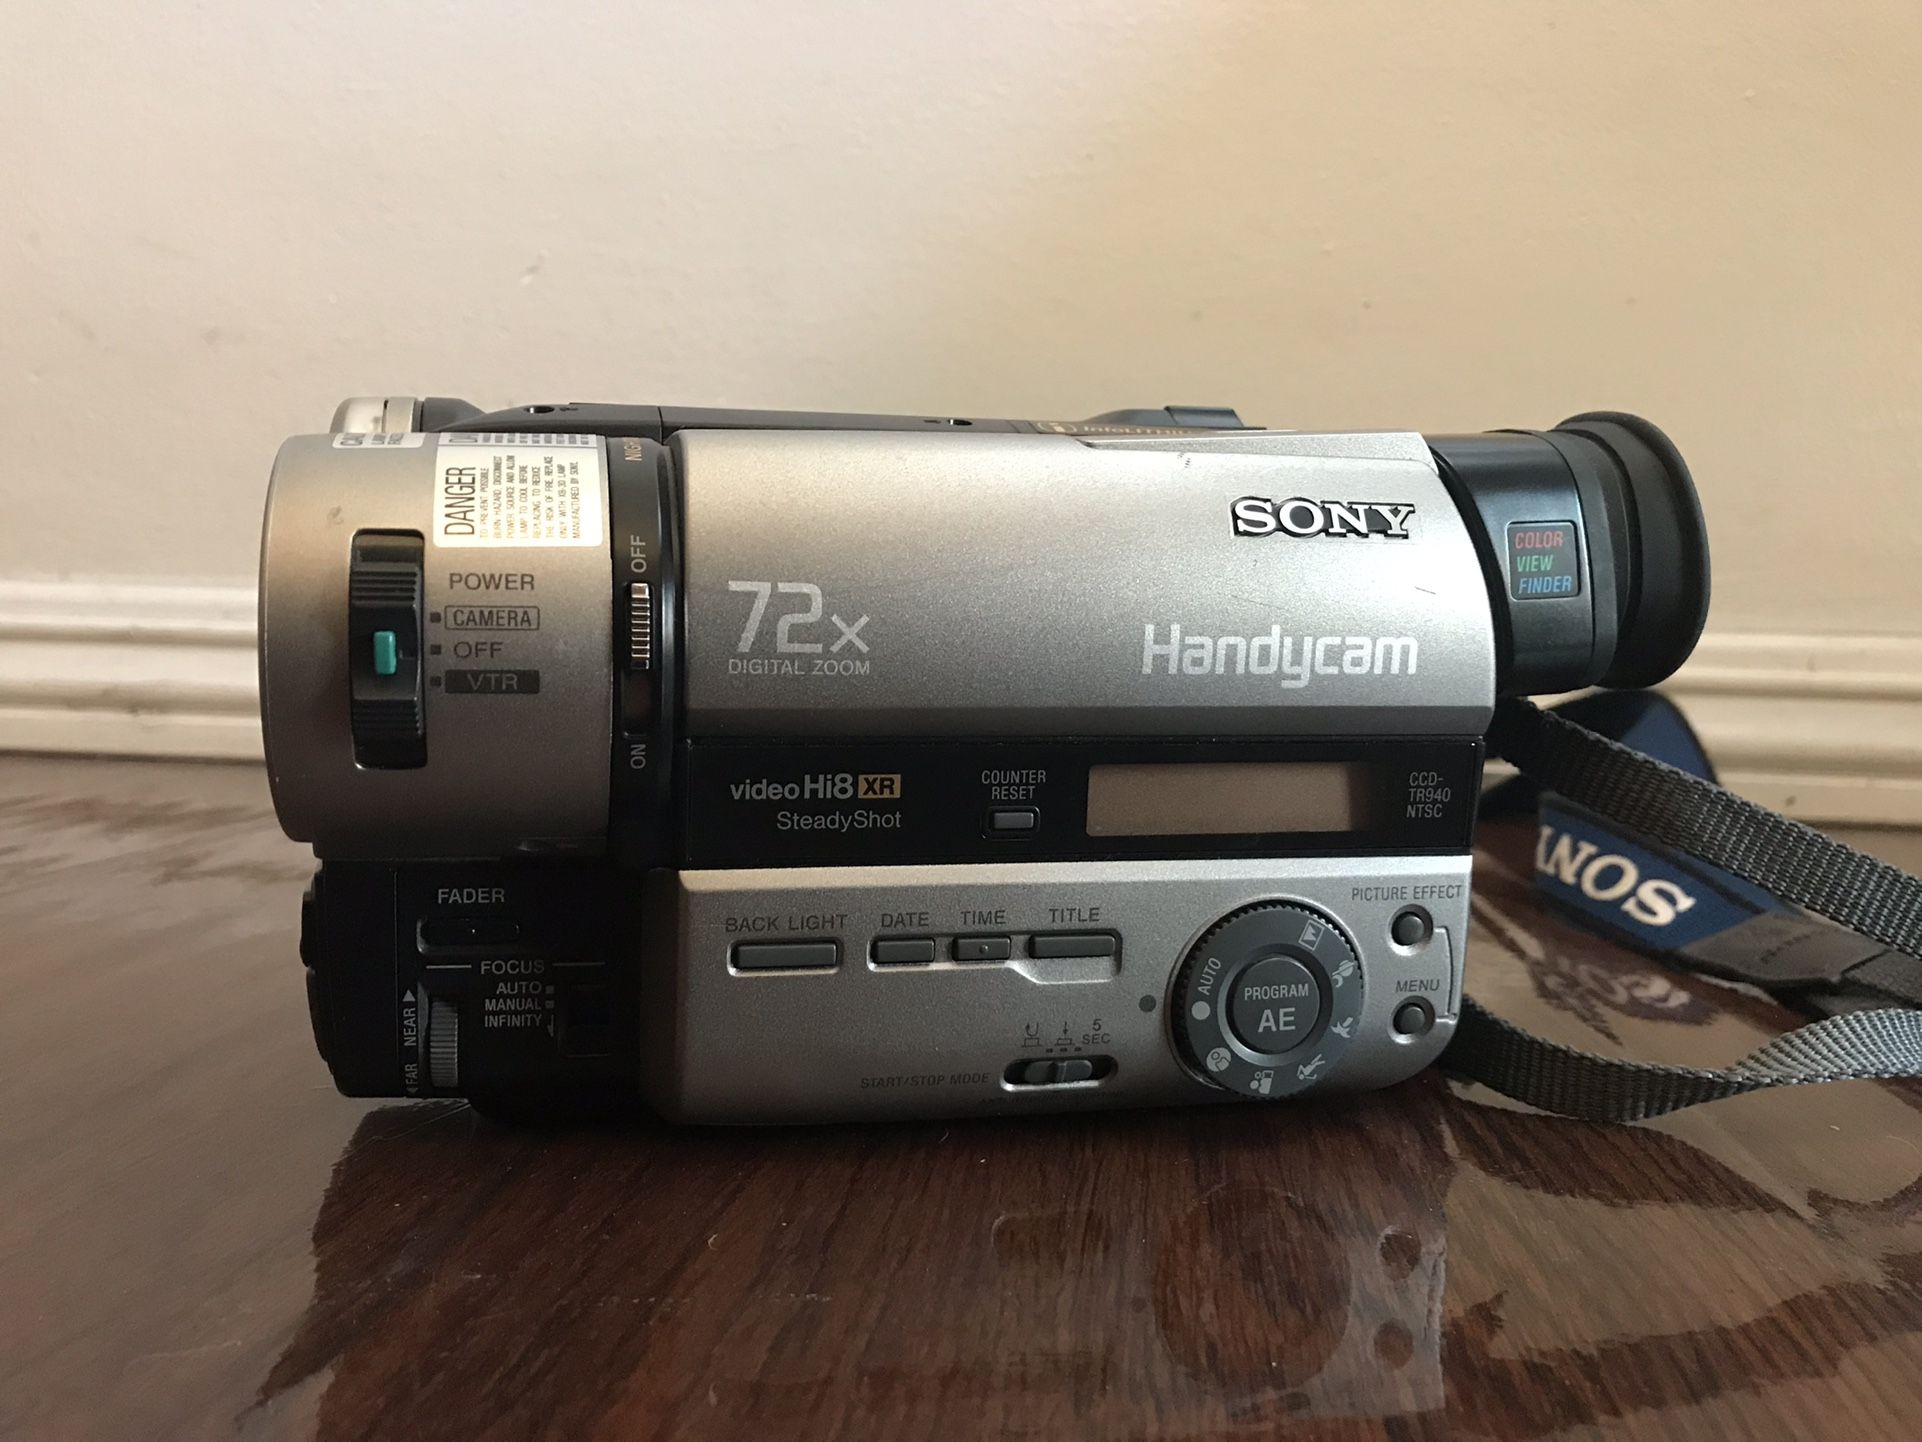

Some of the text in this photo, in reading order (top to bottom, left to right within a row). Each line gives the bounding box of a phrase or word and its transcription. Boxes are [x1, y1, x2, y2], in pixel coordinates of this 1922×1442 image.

[623, 437, 642, 461] NIGH
[480, 467, 489, 493] POSSIBLE
[506, 472, 516, 484] AND
[519, 464, 528, 484] BEFORE
[532, 466, 541, 486] REDUCE
[444, 467, 476, 535] DANGER
[506, 486, 516, 510] SOURCE
[519, 488, 528, 503] COOL
[532, 488, 541, 497] TO
[544, 495, 554, 503] OF
[480, 496, 489, 526] PREVENT
[519, 506, 528, 515] TO
[544, 506, 554, 521] RISK
[557, 500, 567, 518] WITH
[570, 487, 580, 539] MANUFACTURED
[1231, 497, 1415, 539] SONY
[1515, 531, 1564, 549] COLOR
[631, 535, 647, 573] OFF
[1516, 555, 1554, 572] VIEW
[449, 573, 535, 590] POWER
[1518, 576, 1572, 594] FINDER
[453, 609, 532, 627] CAMERA
[453, 642, 503, 658] OFF
[1142, 623, 1418, 688] Handycam
[728, 659, 870, 675] DIGITAL ZOOM
[467, 674, 518, 691] VTR
[630, 743, 646, 769] ON
[981, 770, 1046, 784] COUNTER
[1409, 771, 1444, 787] CCD-
[858, 775, 901, 799] XR
[991, 786, 1036, 800] RESET
[1408, 787, 1451, 803] TR940
[1406, 804, 1443, 818] NTSC
[776, 811, 902, 832] SteadyShot
[437, 887, 505, 904] FADER
[1351, 885, 1462, 901] PICTURE EFFECT
[725, 914, 848, 932] BACK LIGHT
[881, 912, 929, 928] DATE
[960, 910, 1006, 925] TIME
[1049, 907, 1100, 923] TITLE
[480, 960, 545, 975] FOCUS
[1197, 957, 1221, 996] AUTO
[496, 981, 542, 995] AUTO
[1244, 983, 1309, 1000] PROGRAM
[1395, 979, 1440, 993] MENU
[484, 998, 542, 1012] MANUAL
[403, 1007, 417, 1046] NEAR
[484, 1014, 542, 1028] INFINITY
[1092, 1019, 1102, 1031] 5
[1257, 1007, 1296, 1033] AE
[1081, 1033, 1111, 1045] SEC
[405, 1063, 418, 1085] FAR
[860, 1072, 991, 1089] START/STOP MODE
